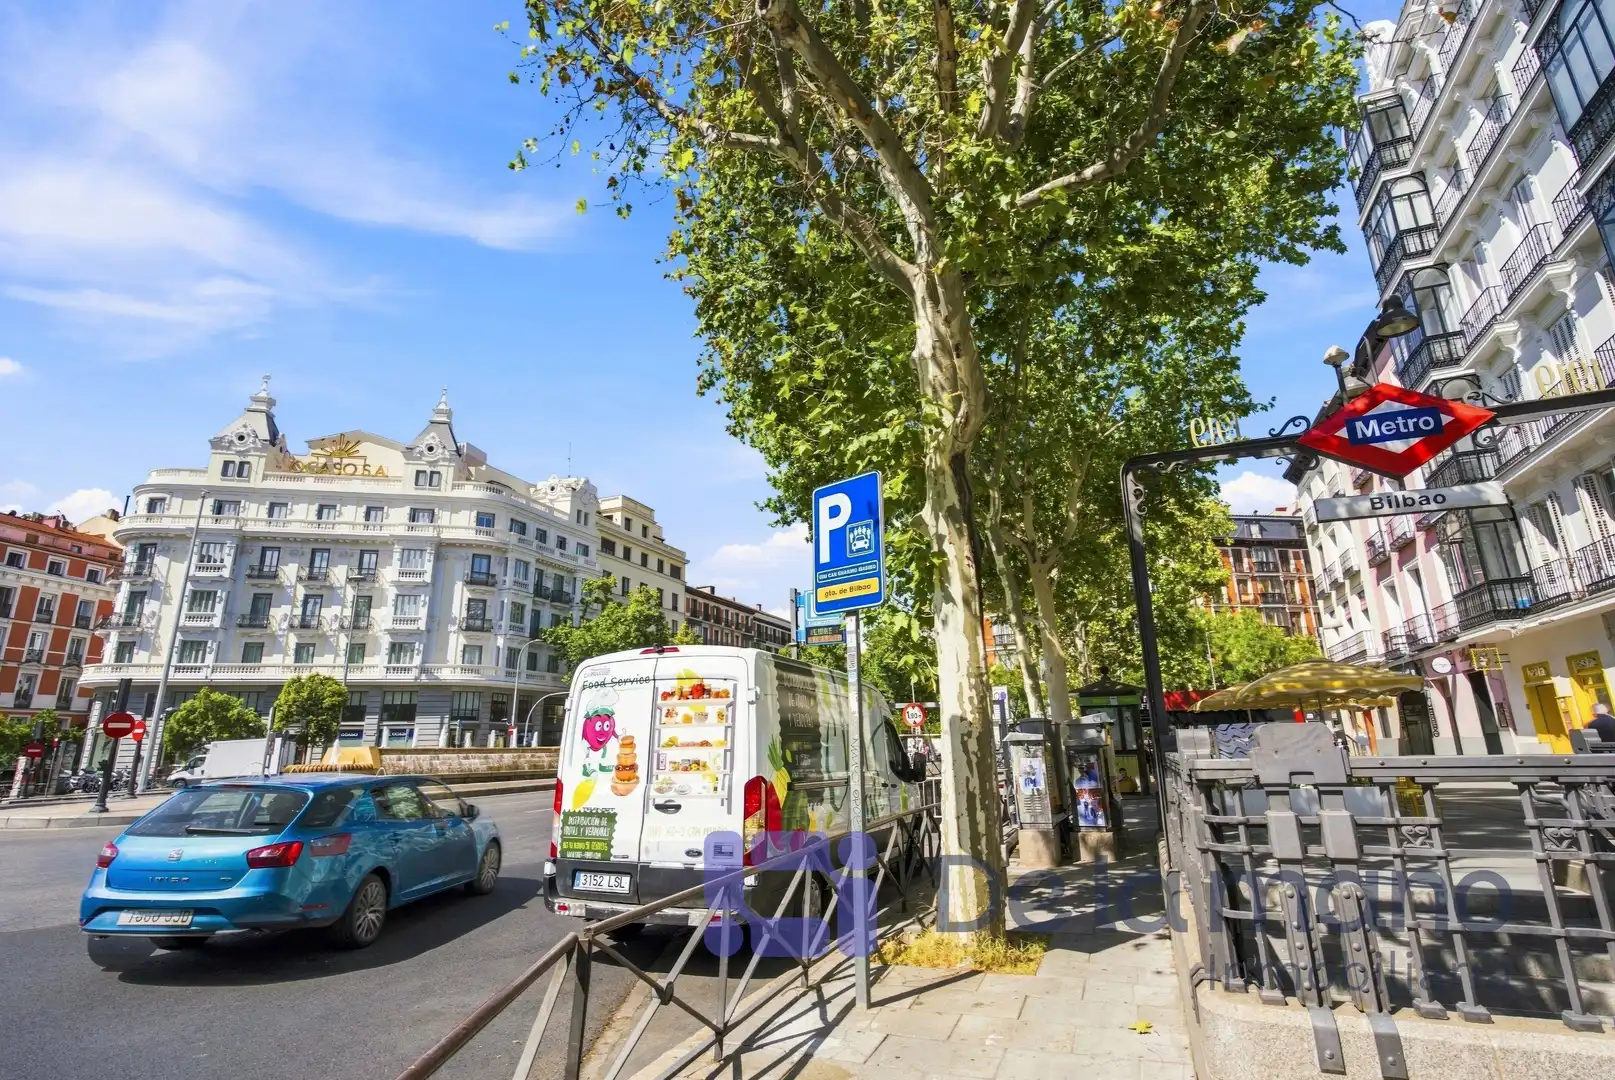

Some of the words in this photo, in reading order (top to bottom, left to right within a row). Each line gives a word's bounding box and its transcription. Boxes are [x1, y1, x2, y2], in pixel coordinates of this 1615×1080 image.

[1355, 415, 1435, 440] Metro
[290, 459, 358, 477] OCASO
[1369, 493, 1447, 511] Bilbao
[819, 492, 852, 564] P
[849, 583, 872, 593] Bilbao
[583, 678, 607, 690] Food
[610, 673, 651, 688] Service
[581, 874, 604, 887] 3152
[607, 876, 626, 889] LSL
